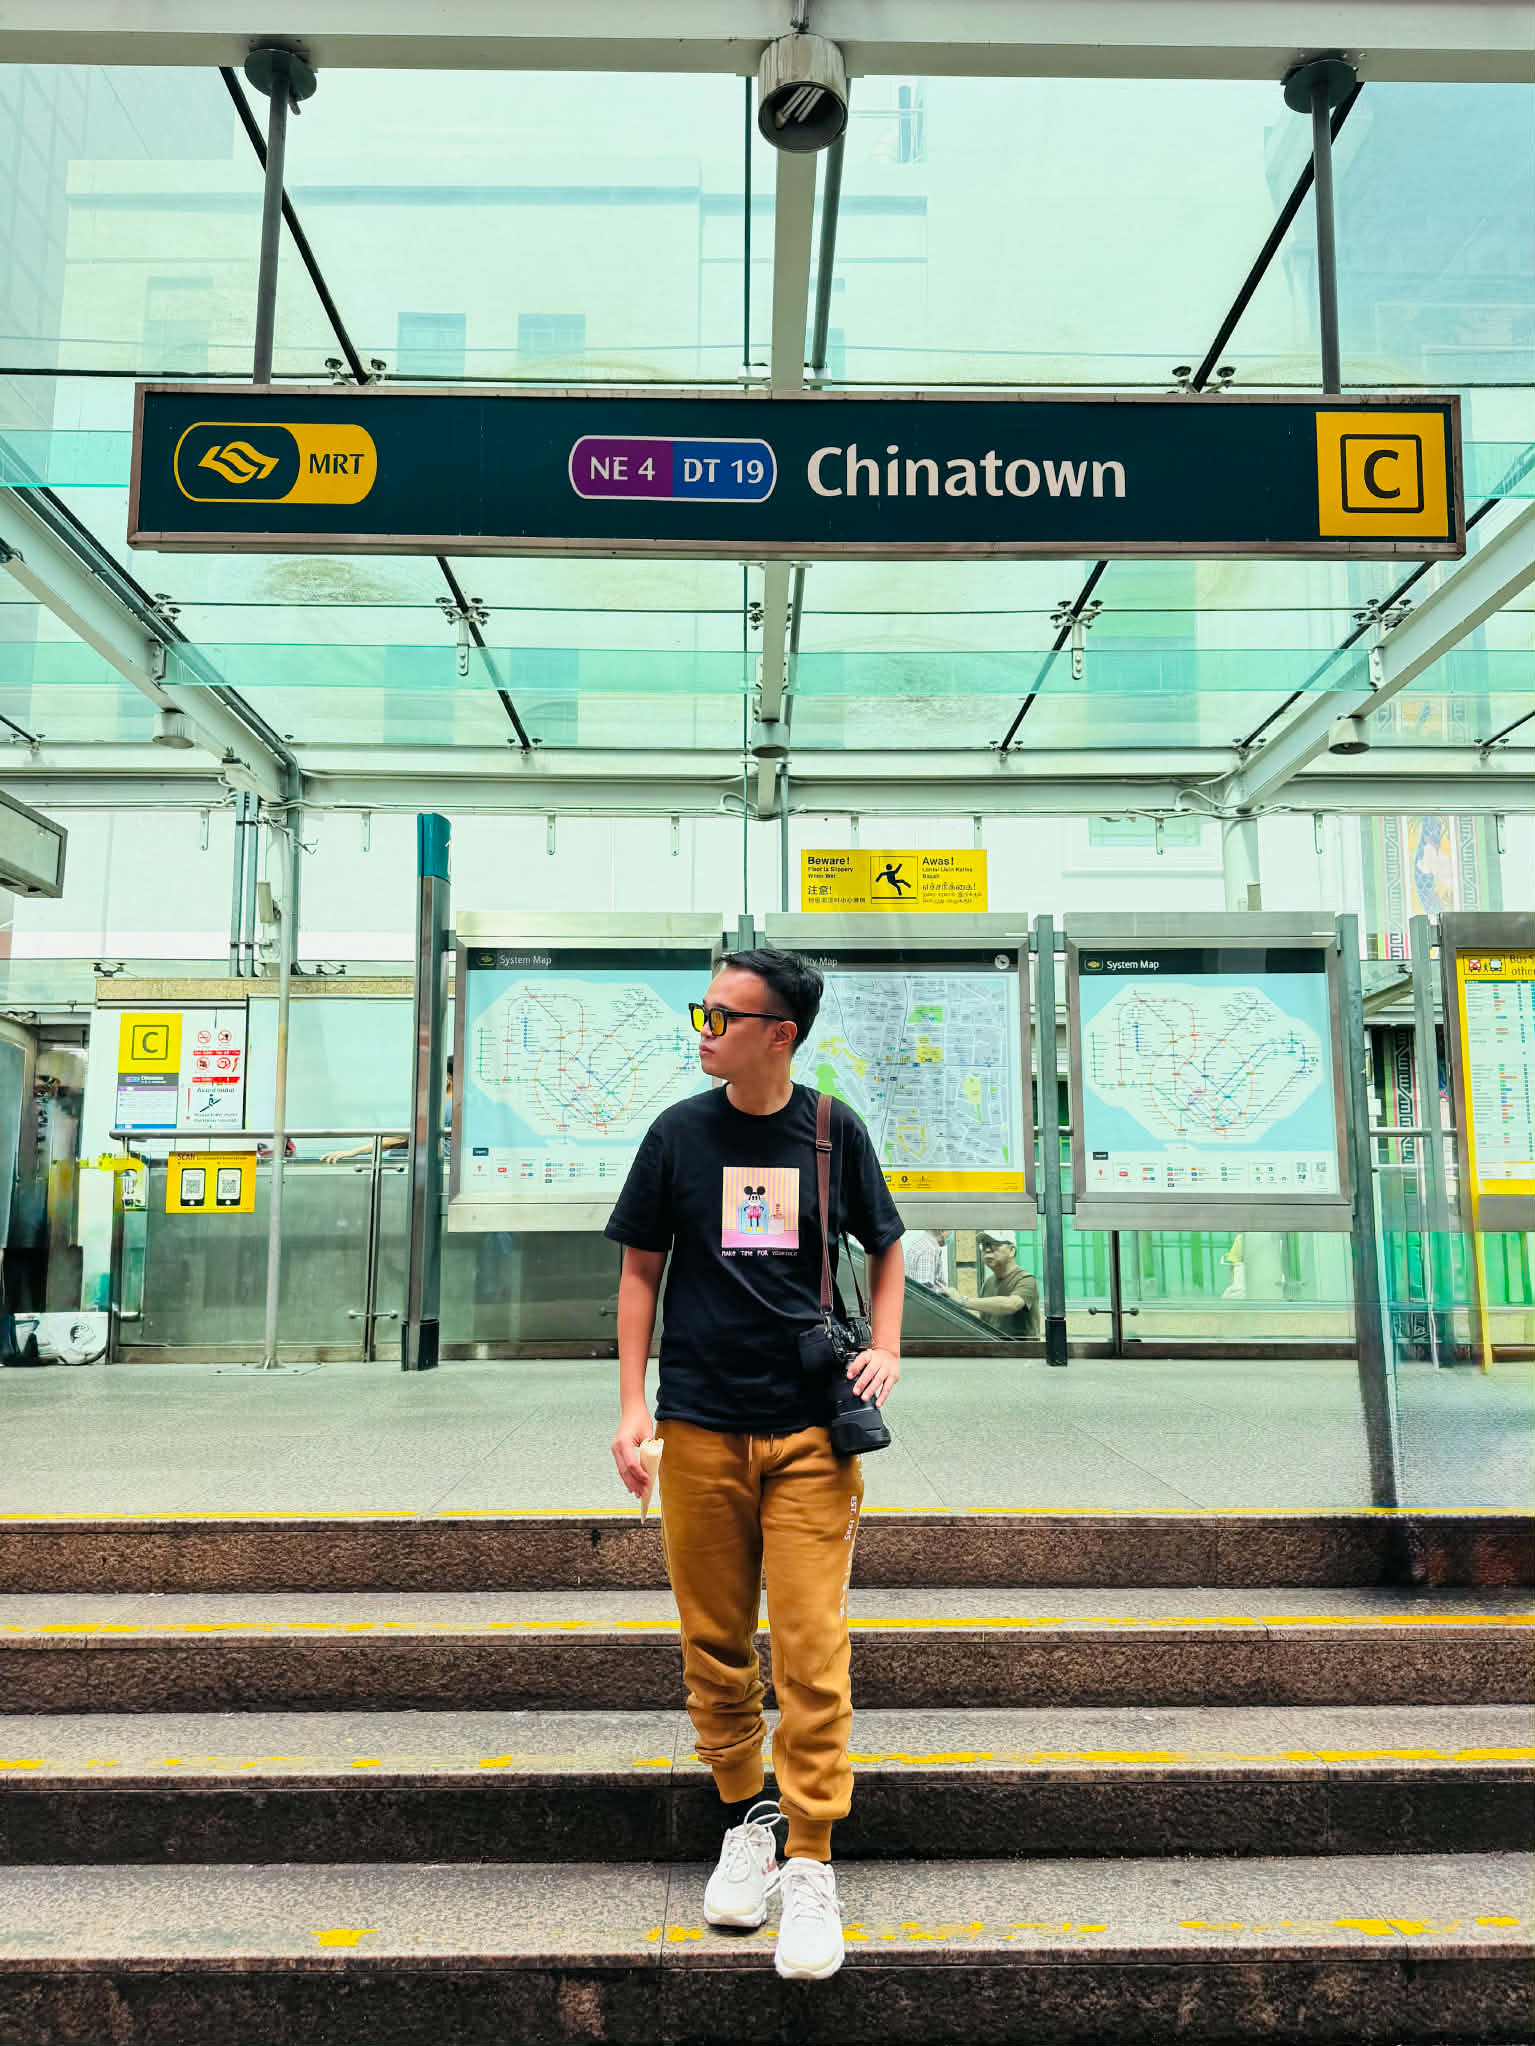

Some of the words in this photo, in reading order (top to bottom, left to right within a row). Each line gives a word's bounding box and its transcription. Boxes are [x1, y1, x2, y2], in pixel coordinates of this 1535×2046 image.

[309, 453, 365, 475] MRT
[590, 456, 628, 480] NE
[637, 457, 656, 481] 4
[683, 458, 721, 483] DT
[730, 459, 764, 484] 19
[807, 443, 1126, 498] Chinatown
[1363, 449, 1401, 499] C
[807, 856, 850, 865] Beware!
[922, 856, 954, 866] Awas!
[499, 954, 531, 967] System
[532, 955, 552, 967] Map
[819, 957, 839, 968] Map
[1106, 960, 1139, 971] System
[1140, 960, 1160, 971] Map
[142, 1031, 159, 1054] C
